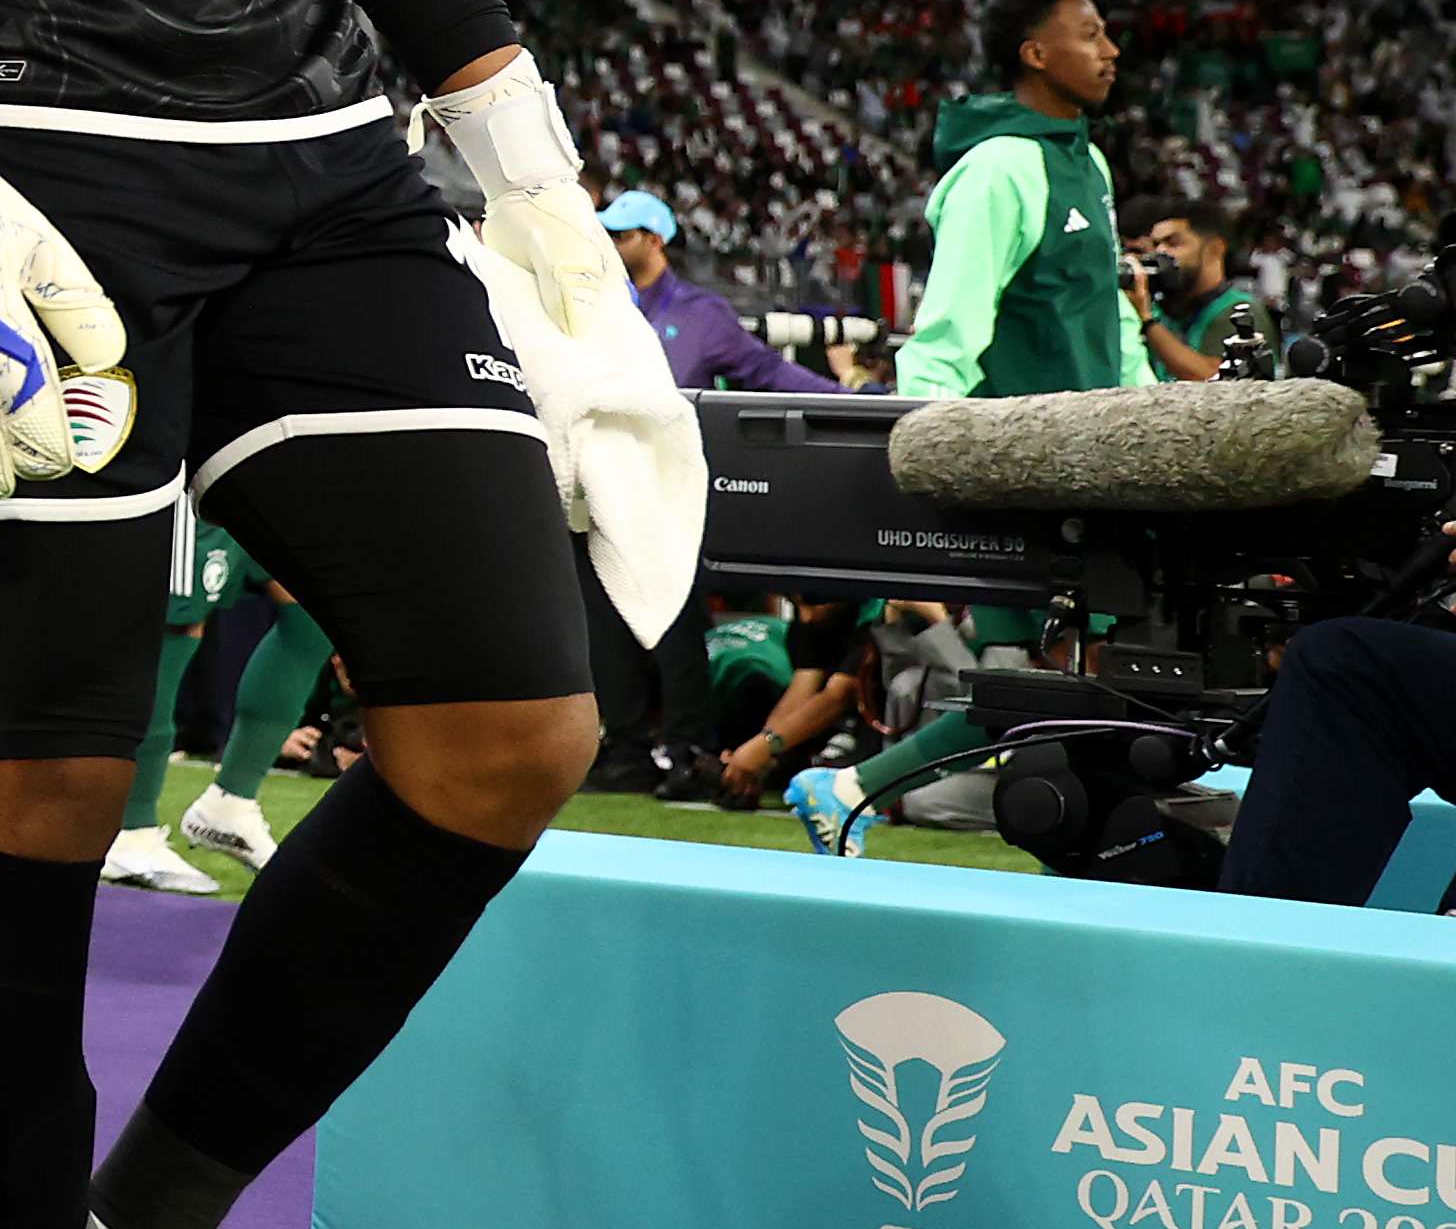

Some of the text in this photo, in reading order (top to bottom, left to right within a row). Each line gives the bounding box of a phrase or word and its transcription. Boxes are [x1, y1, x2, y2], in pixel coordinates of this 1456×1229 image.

[714, 476, 769, 494] Canon
[877, 529, 912, 547] UHD
[915, 531, 999, 551] DIGISUPER
[1224, 1056, 1365, 1118] AFC
[1051, 1093, 1340, 1194] ASIAN
[1076, 1169, 1313, 1229] QATAR
